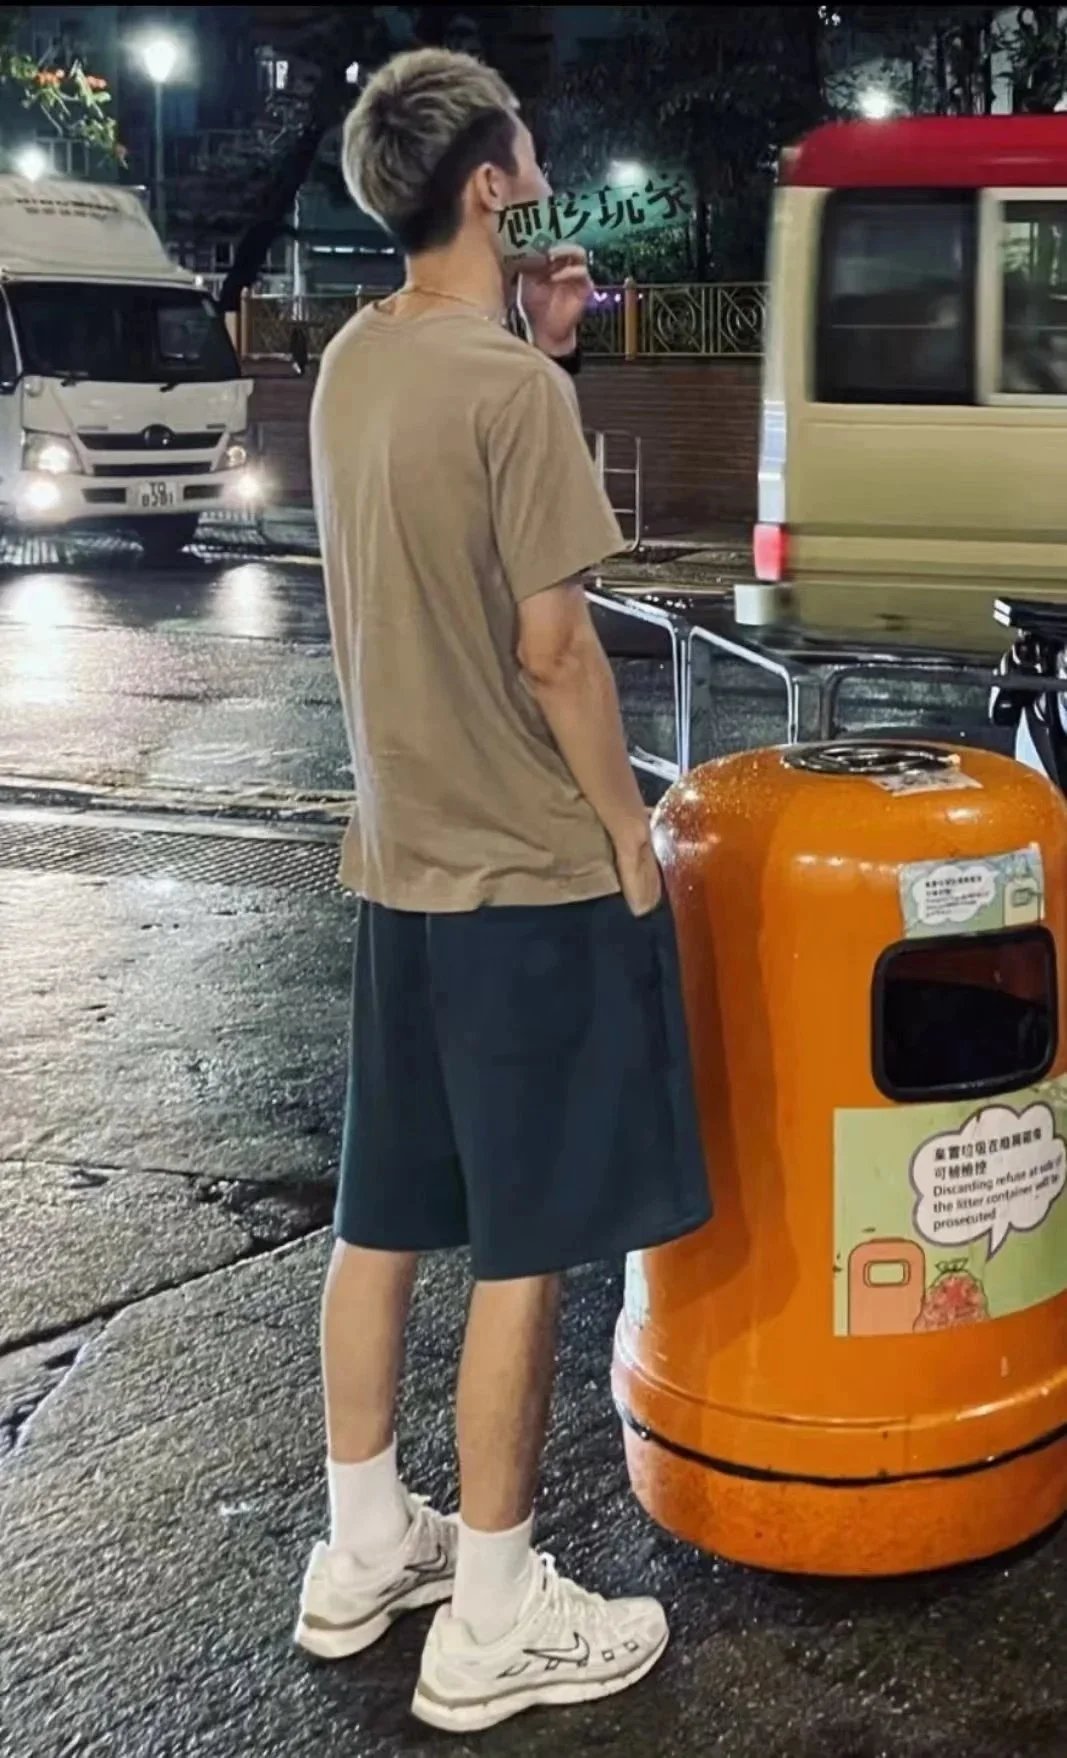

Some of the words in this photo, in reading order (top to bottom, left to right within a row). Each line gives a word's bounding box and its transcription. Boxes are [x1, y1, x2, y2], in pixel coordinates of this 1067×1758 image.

[933, 1179, 994, 1198] Discarding
[996, 1170, 1026, 1185] refuse
[1029, 1166, 1038, 1177] at
[933, 1200, 954, 1214] the
[956, 1195, 983, 1210] litter
[986, 1184, 1033, 1205] container
[933, 1207, 997, 1233] prosecuted
